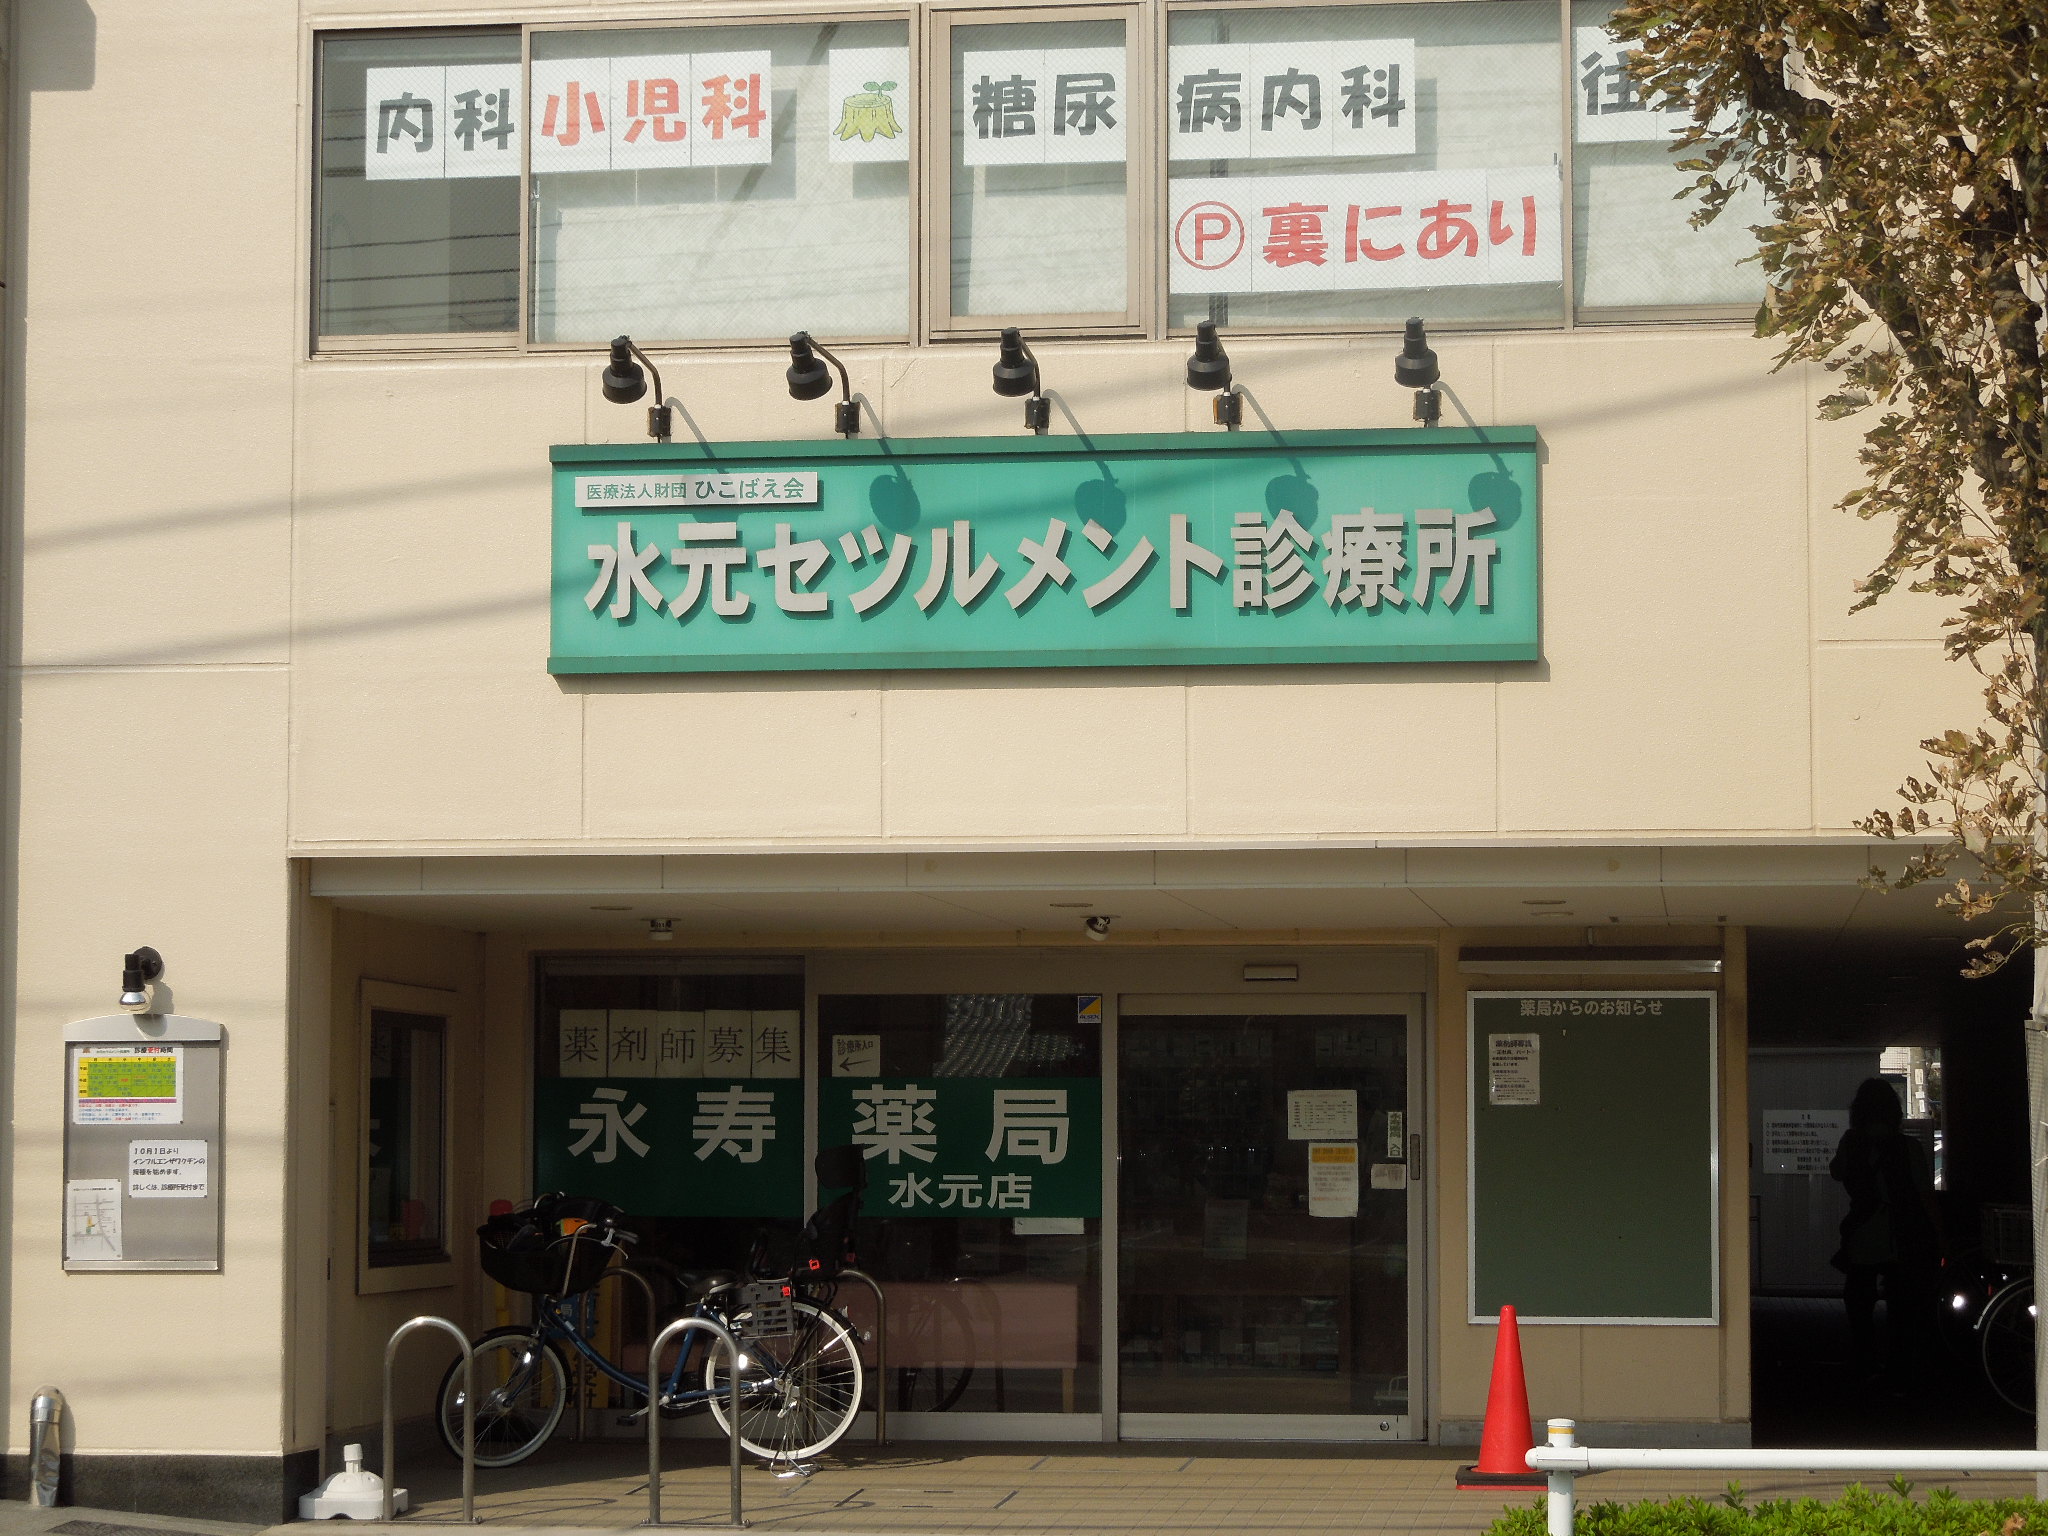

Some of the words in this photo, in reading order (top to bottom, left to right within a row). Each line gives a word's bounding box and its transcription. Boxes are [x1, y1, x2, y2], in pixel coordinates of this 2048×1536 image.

[376, 89, 514, 153] 内科
[541, 74, 766, 146] 小児科
[972, 64, 1405, 139] 糖尿病内科
[587, 482, 686, 500] 医療法人財団
[695, 477, 804, 499] ひこばえ会
[584, 506, 1497, 618] 水元セツルメント診療所
[1520, 1000, 1663, 1016] 薬局からのお知らせ
[563, 1026, 792, 1064] 薬剤師募集
[133, 1157, 206, 1165] インフルエンザワクチンの
[134, 1147, 179, 1155] 10月1日より
[888, 1172, 1033, 1210] 水元店
